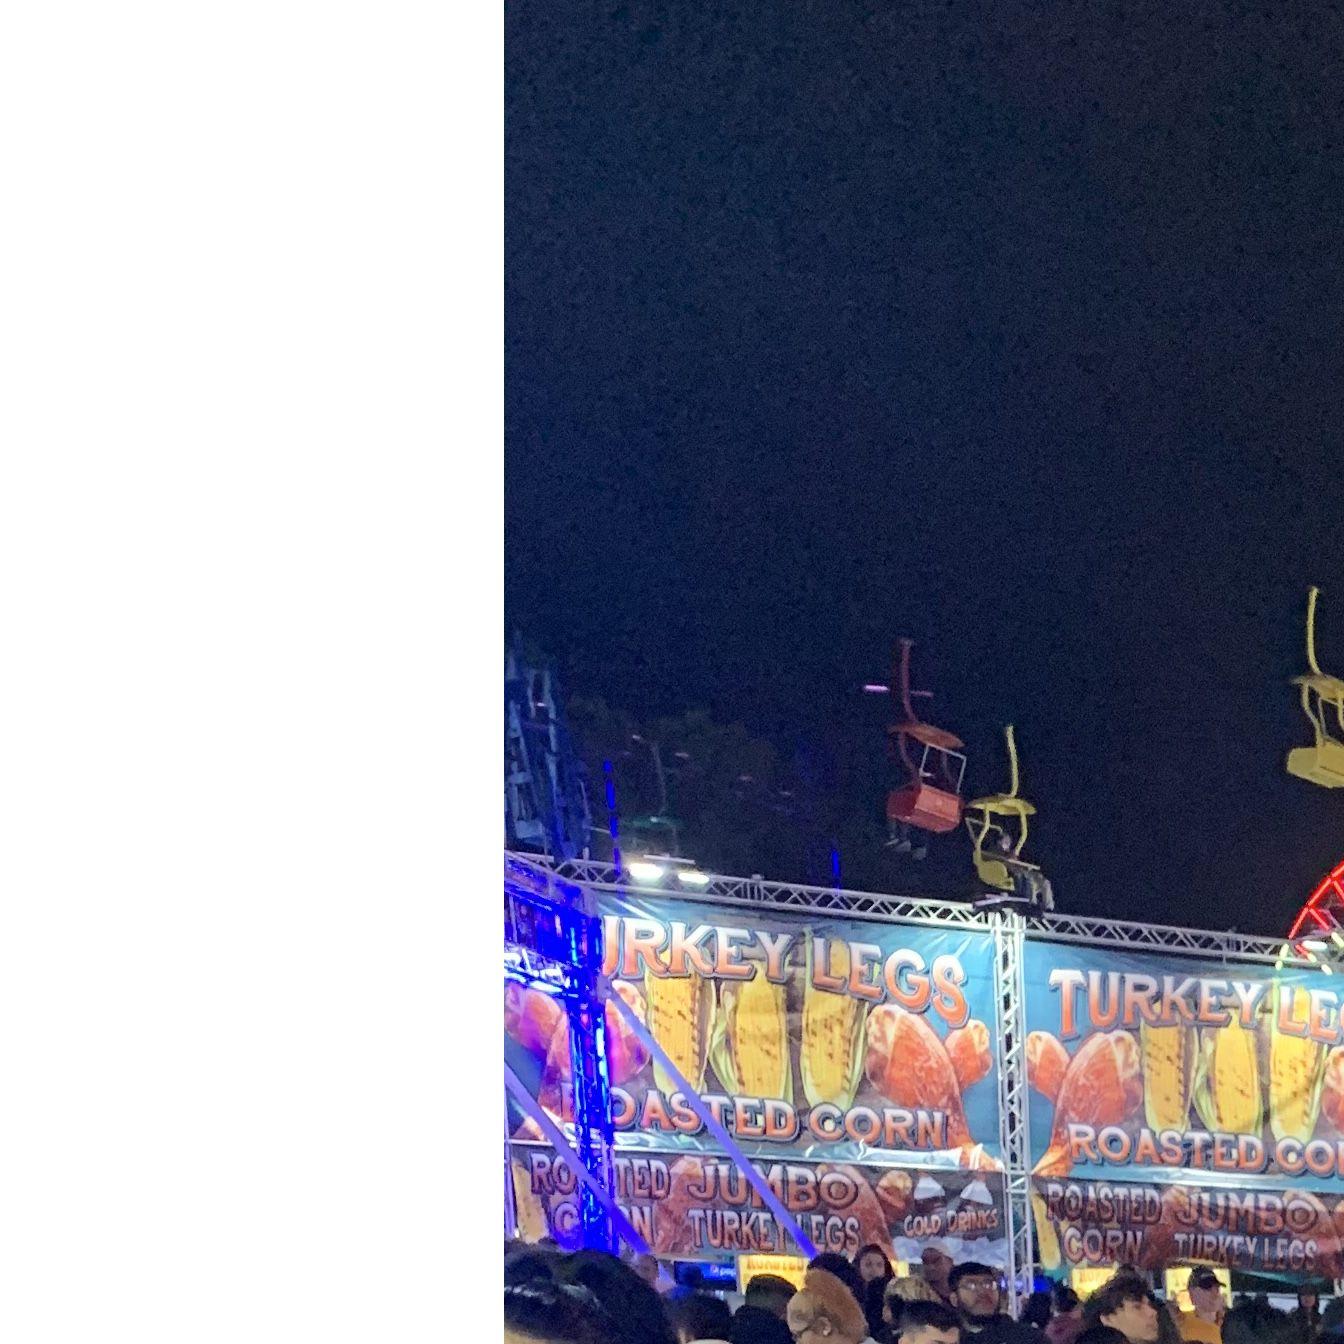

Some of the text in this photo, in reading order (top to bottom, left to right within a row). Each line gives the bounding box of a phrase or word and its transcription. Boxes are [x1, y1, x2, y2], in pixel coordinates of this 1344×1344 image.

[602, 915, 969, 1028] RKEY LEGS
[1047, 968, 1264, 1038] TURKEY
[809, 1102, 948, 1149] CORN
[1066, 1124, 1264, 1170] ROASTED
[530, 1152, 860, 1212] ROTED JUMBO
[904, 1208, 999, 1237] COLD DRINKS
[1045, 1182, 1318, 1235] ROASTED JUMBO
[1062, 1225, 1318, 1270] CORN TURKEY LEGS
